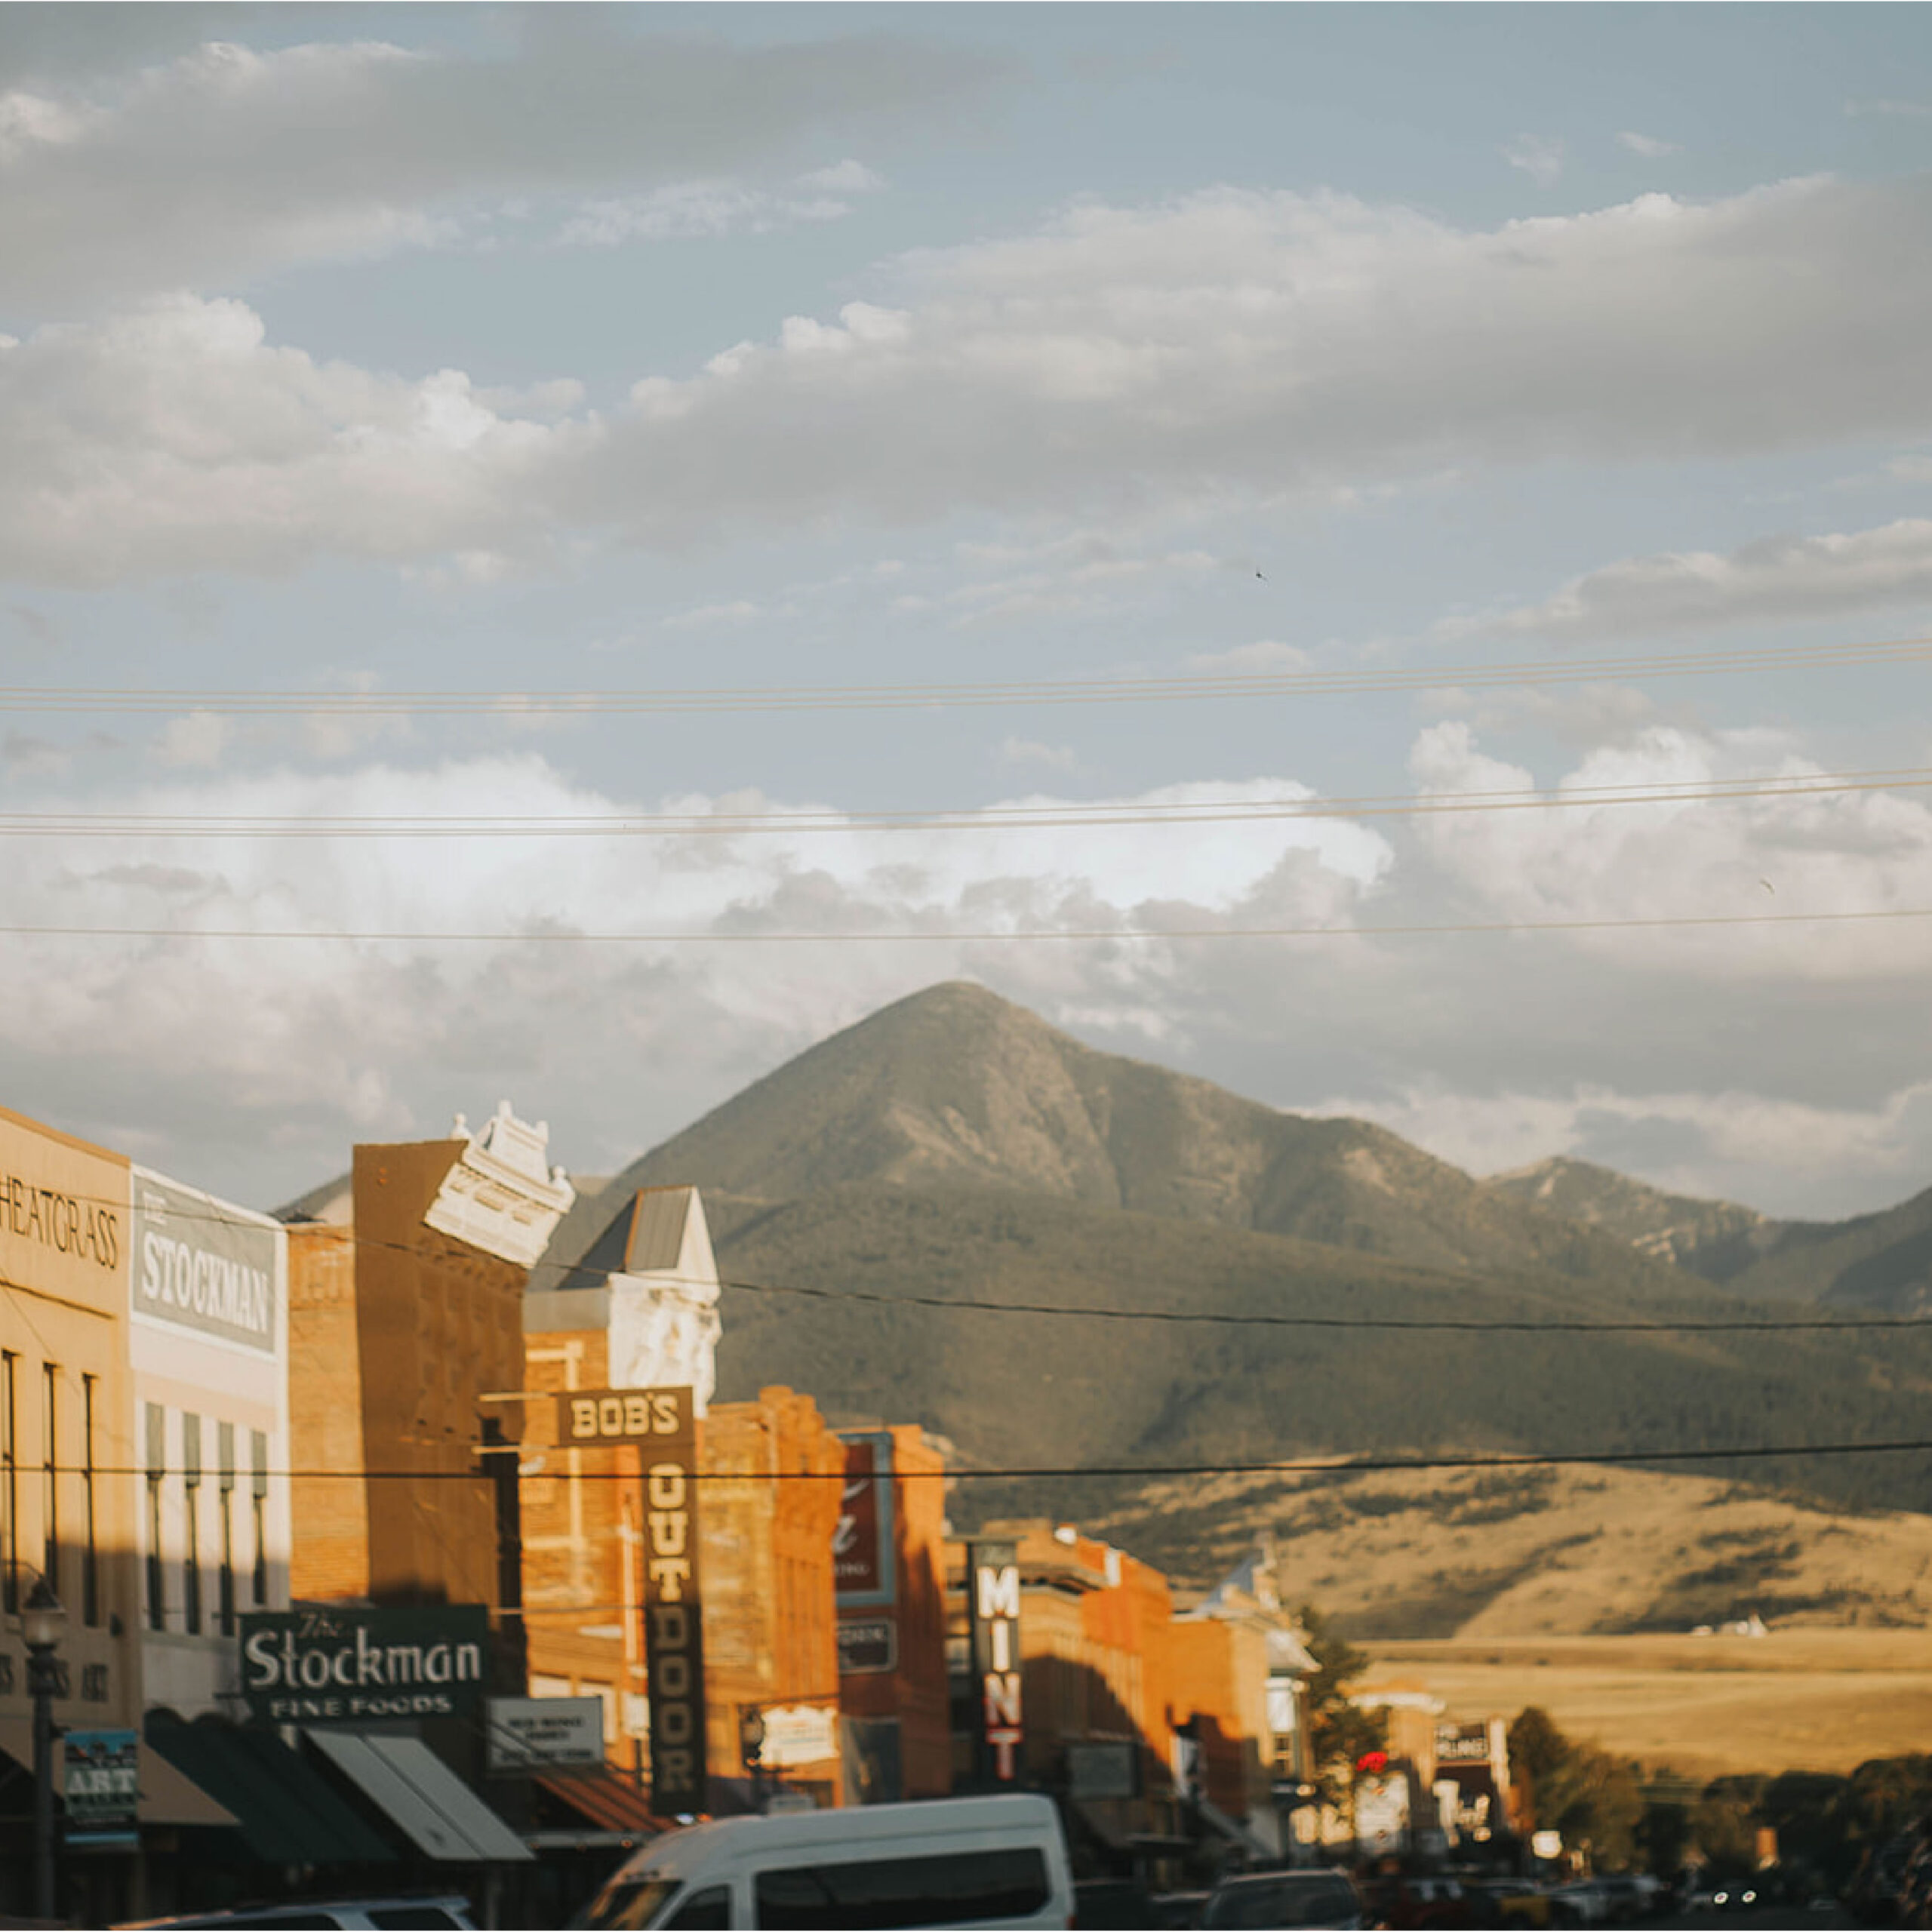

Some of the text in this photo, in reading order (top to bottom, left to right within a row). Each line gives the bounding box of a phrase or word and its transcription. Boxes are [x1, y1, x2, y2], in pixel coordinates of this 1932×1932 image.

[142, 1232, 269, 1334] STOCKMAN
[571, 1392, 678, 1437] BOB'S
[245, 1626, 481, 1689] Stockman
[978, 1566, 1022, 1780] MINT
[269, 1695, 453, 1718] FINE FOODS
[67, 1767, 136, 1793] ART
